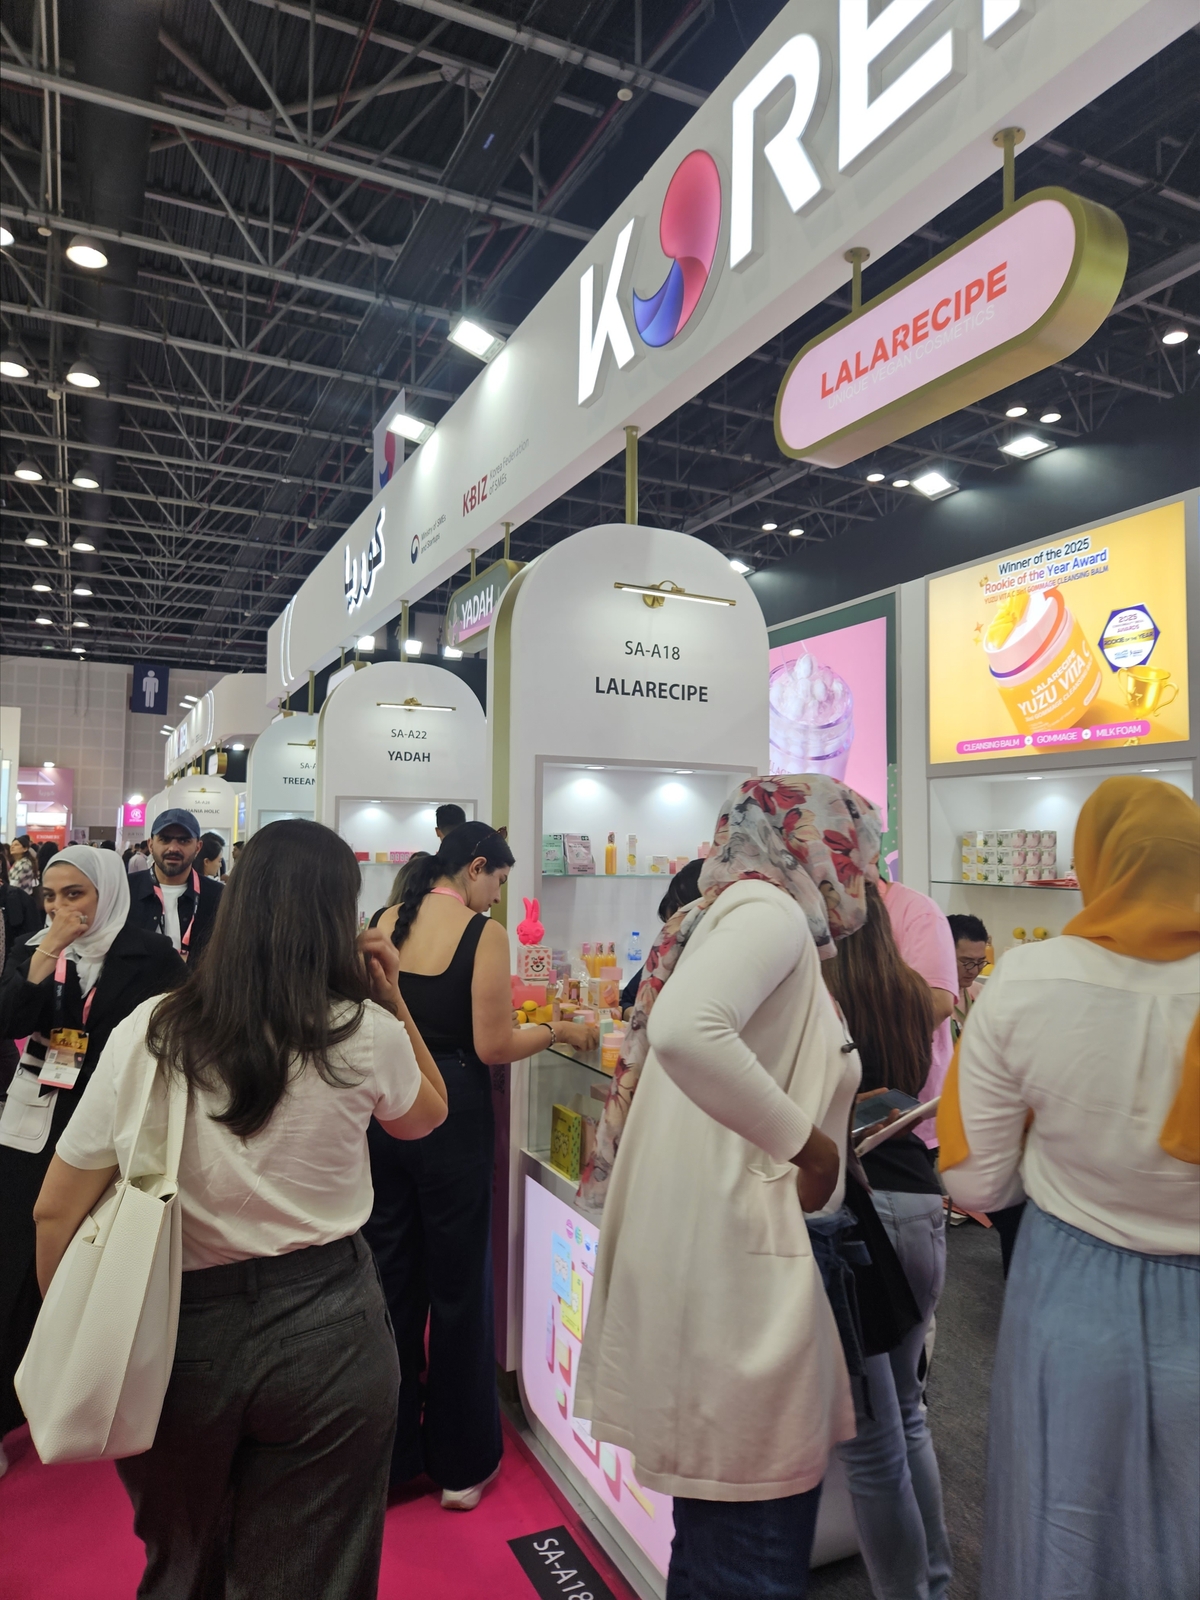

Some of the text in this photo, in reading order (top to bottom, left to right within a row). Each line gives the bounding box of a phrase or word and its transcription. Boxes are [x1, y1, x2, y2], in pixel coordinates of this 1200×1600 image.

[577, 0, 1021, 407] KORE
[821, 260, 1008, 400] LALARECIPE
[828, 304, 995, 410] UNIQUE VEGAN COSMETICS
[489, 438, 529, 480] Korea Federation
[489, 472, 507, 496] of SMEs
[344, 506, 386, 616] كوريا
[984, 549, 1107, 594] Rookie of the Year Award
[998, 538, 1090, 575] Winner of the 2025
[1027, 581, 1056, 593] GOMMAGE
[1057, 571, 1090, 585] CLEANSING
[1090, 565, 1109, 576] BALM
[461, 584, 494, 630] YADAH
[624, 640, 681, 661] SA-A18
[595, 676, 708, 703] LALARECIPE
[1017, 684, 1057, 716] YUZU
[1058, 654, 1086, 690] VITA
[1030, 649, 1077, 696] LALARECIPE
[391, 728, 428, 740] SA-A22
[963, 725, 1142, 752] CLEANSING BALM GOMMAGE MILK FOAM
[387, 750, 431, 763] YADAH
